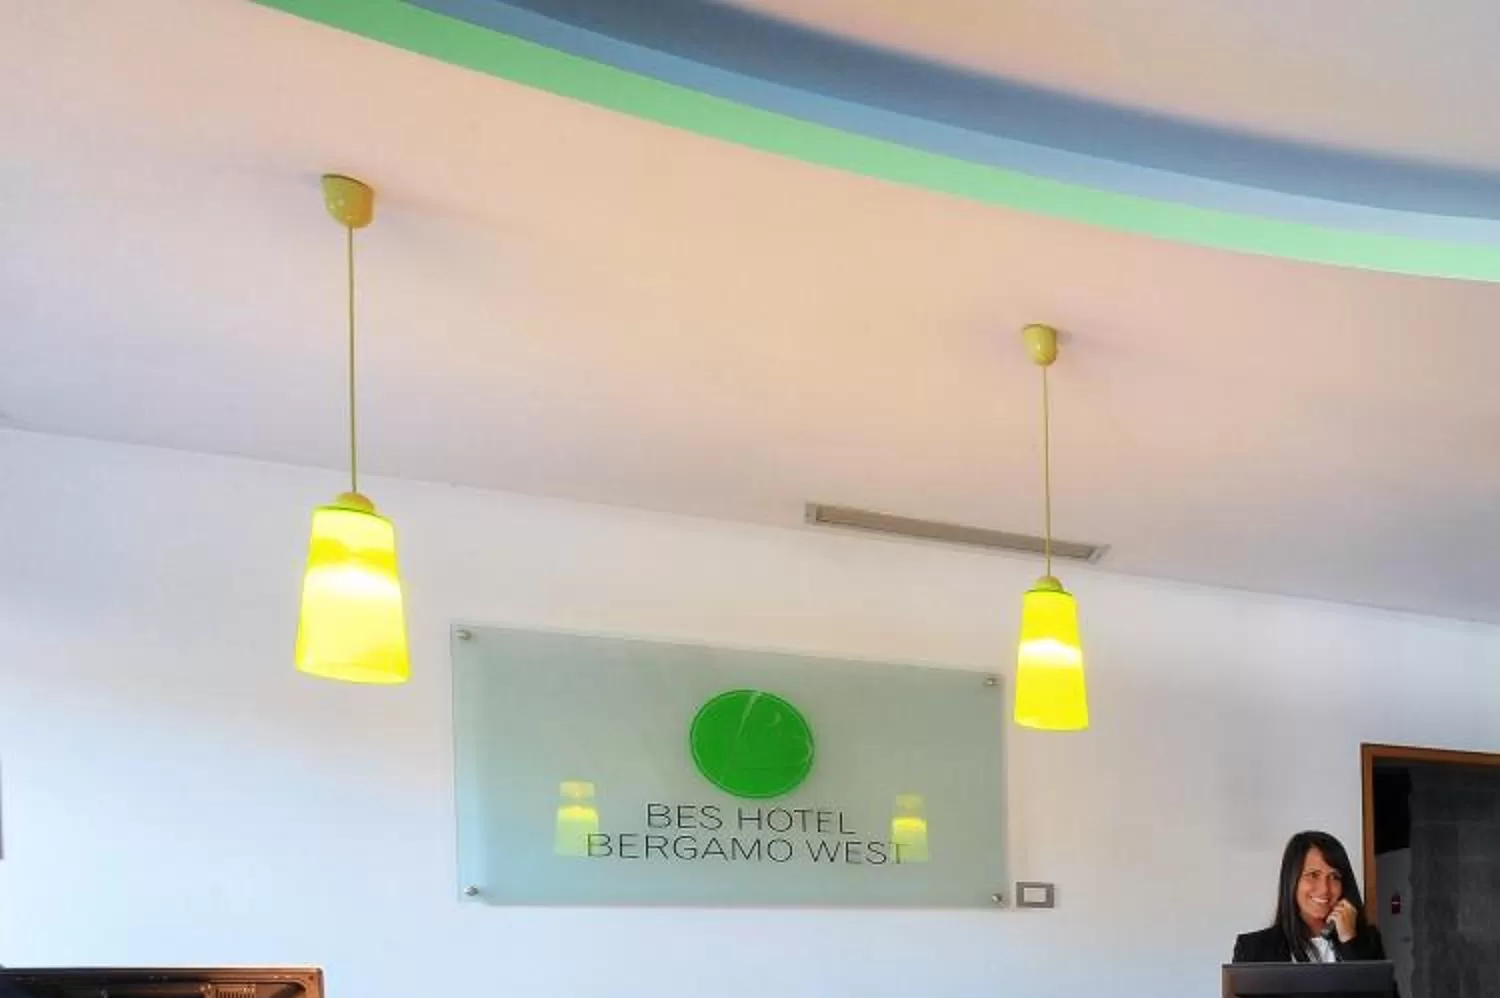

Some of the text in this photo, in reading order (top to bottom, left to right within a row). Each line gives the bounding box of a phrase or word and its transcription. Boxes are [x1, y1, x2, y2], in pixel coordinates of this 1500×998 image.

[646, 803, 857, 835] BES HOTEL
[586, 833, 911, 866] BERGAMO WEST
